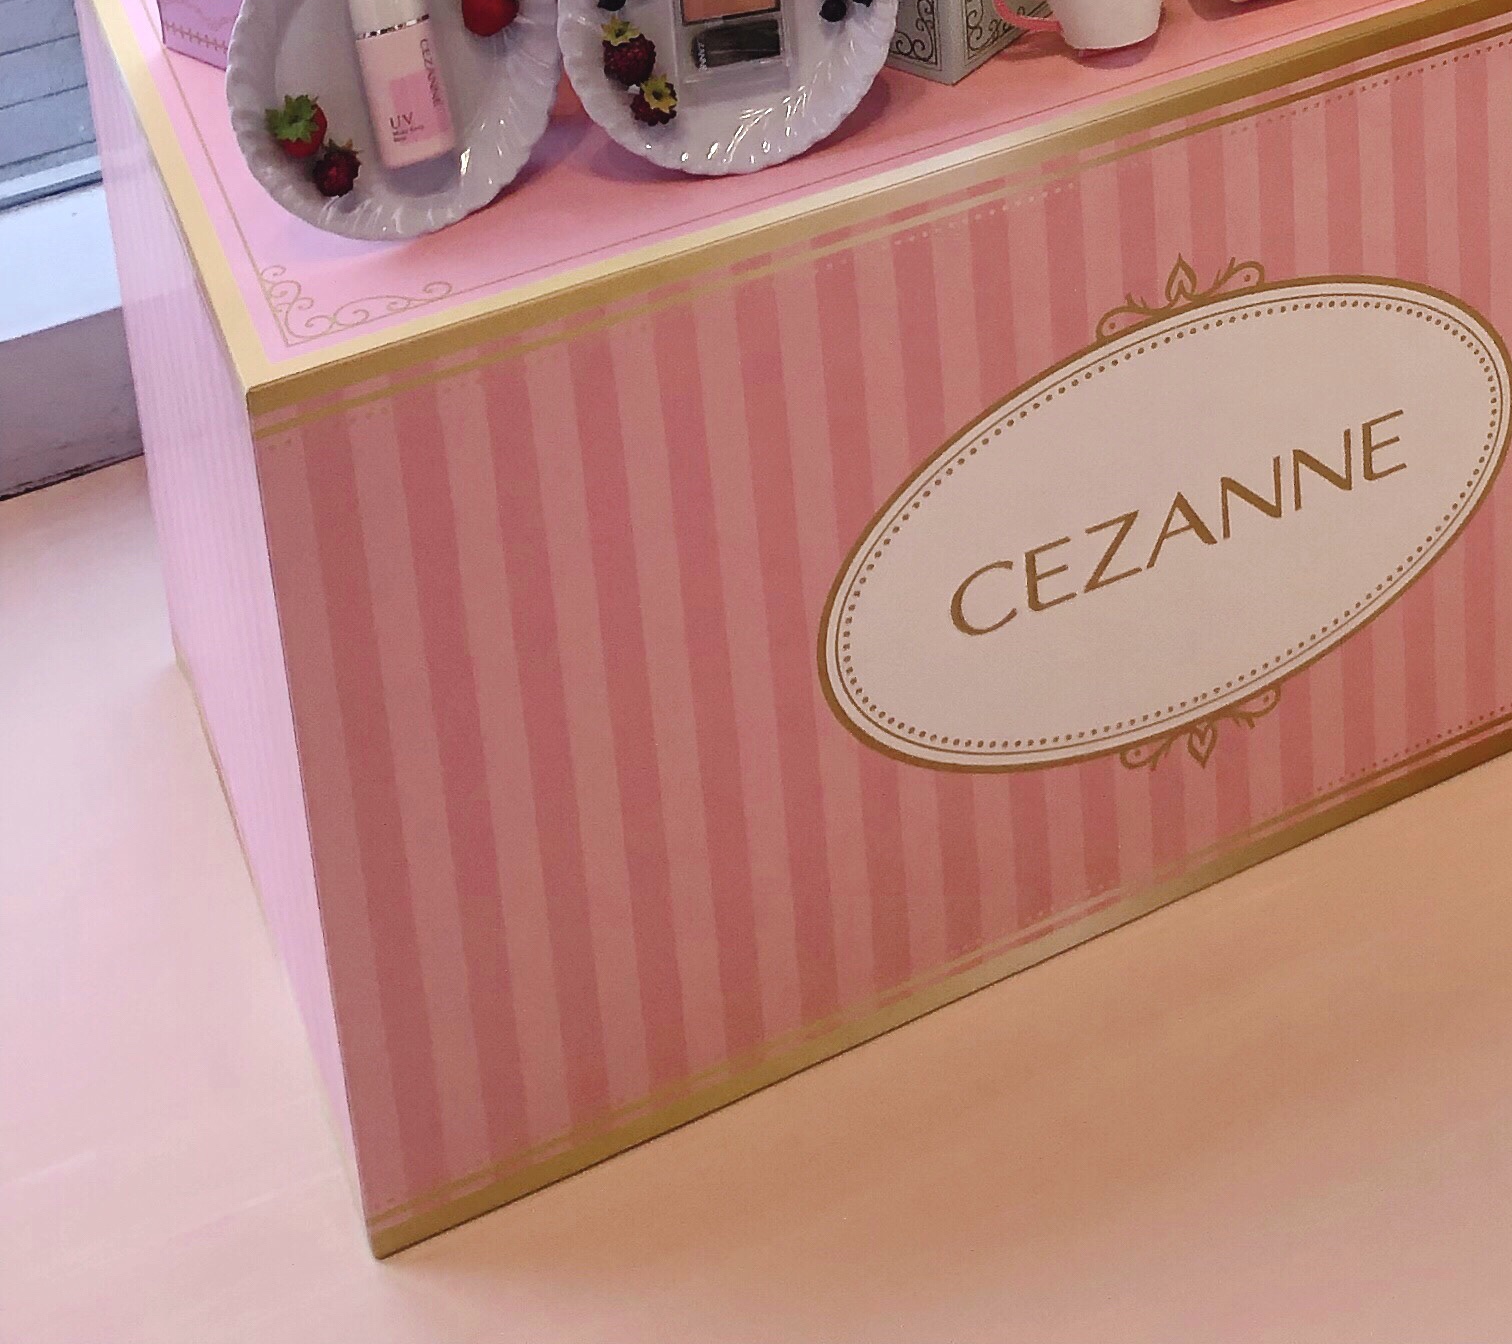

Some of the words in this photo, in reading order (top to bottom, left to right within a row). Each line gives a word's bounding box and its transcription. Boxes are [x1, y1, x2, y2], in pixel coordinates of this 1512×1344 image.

[419, 38, 445, 108] CEZANNE
[389, 111, 413, 130] UV
[949, 409, 1408, 637] CEZANNE
